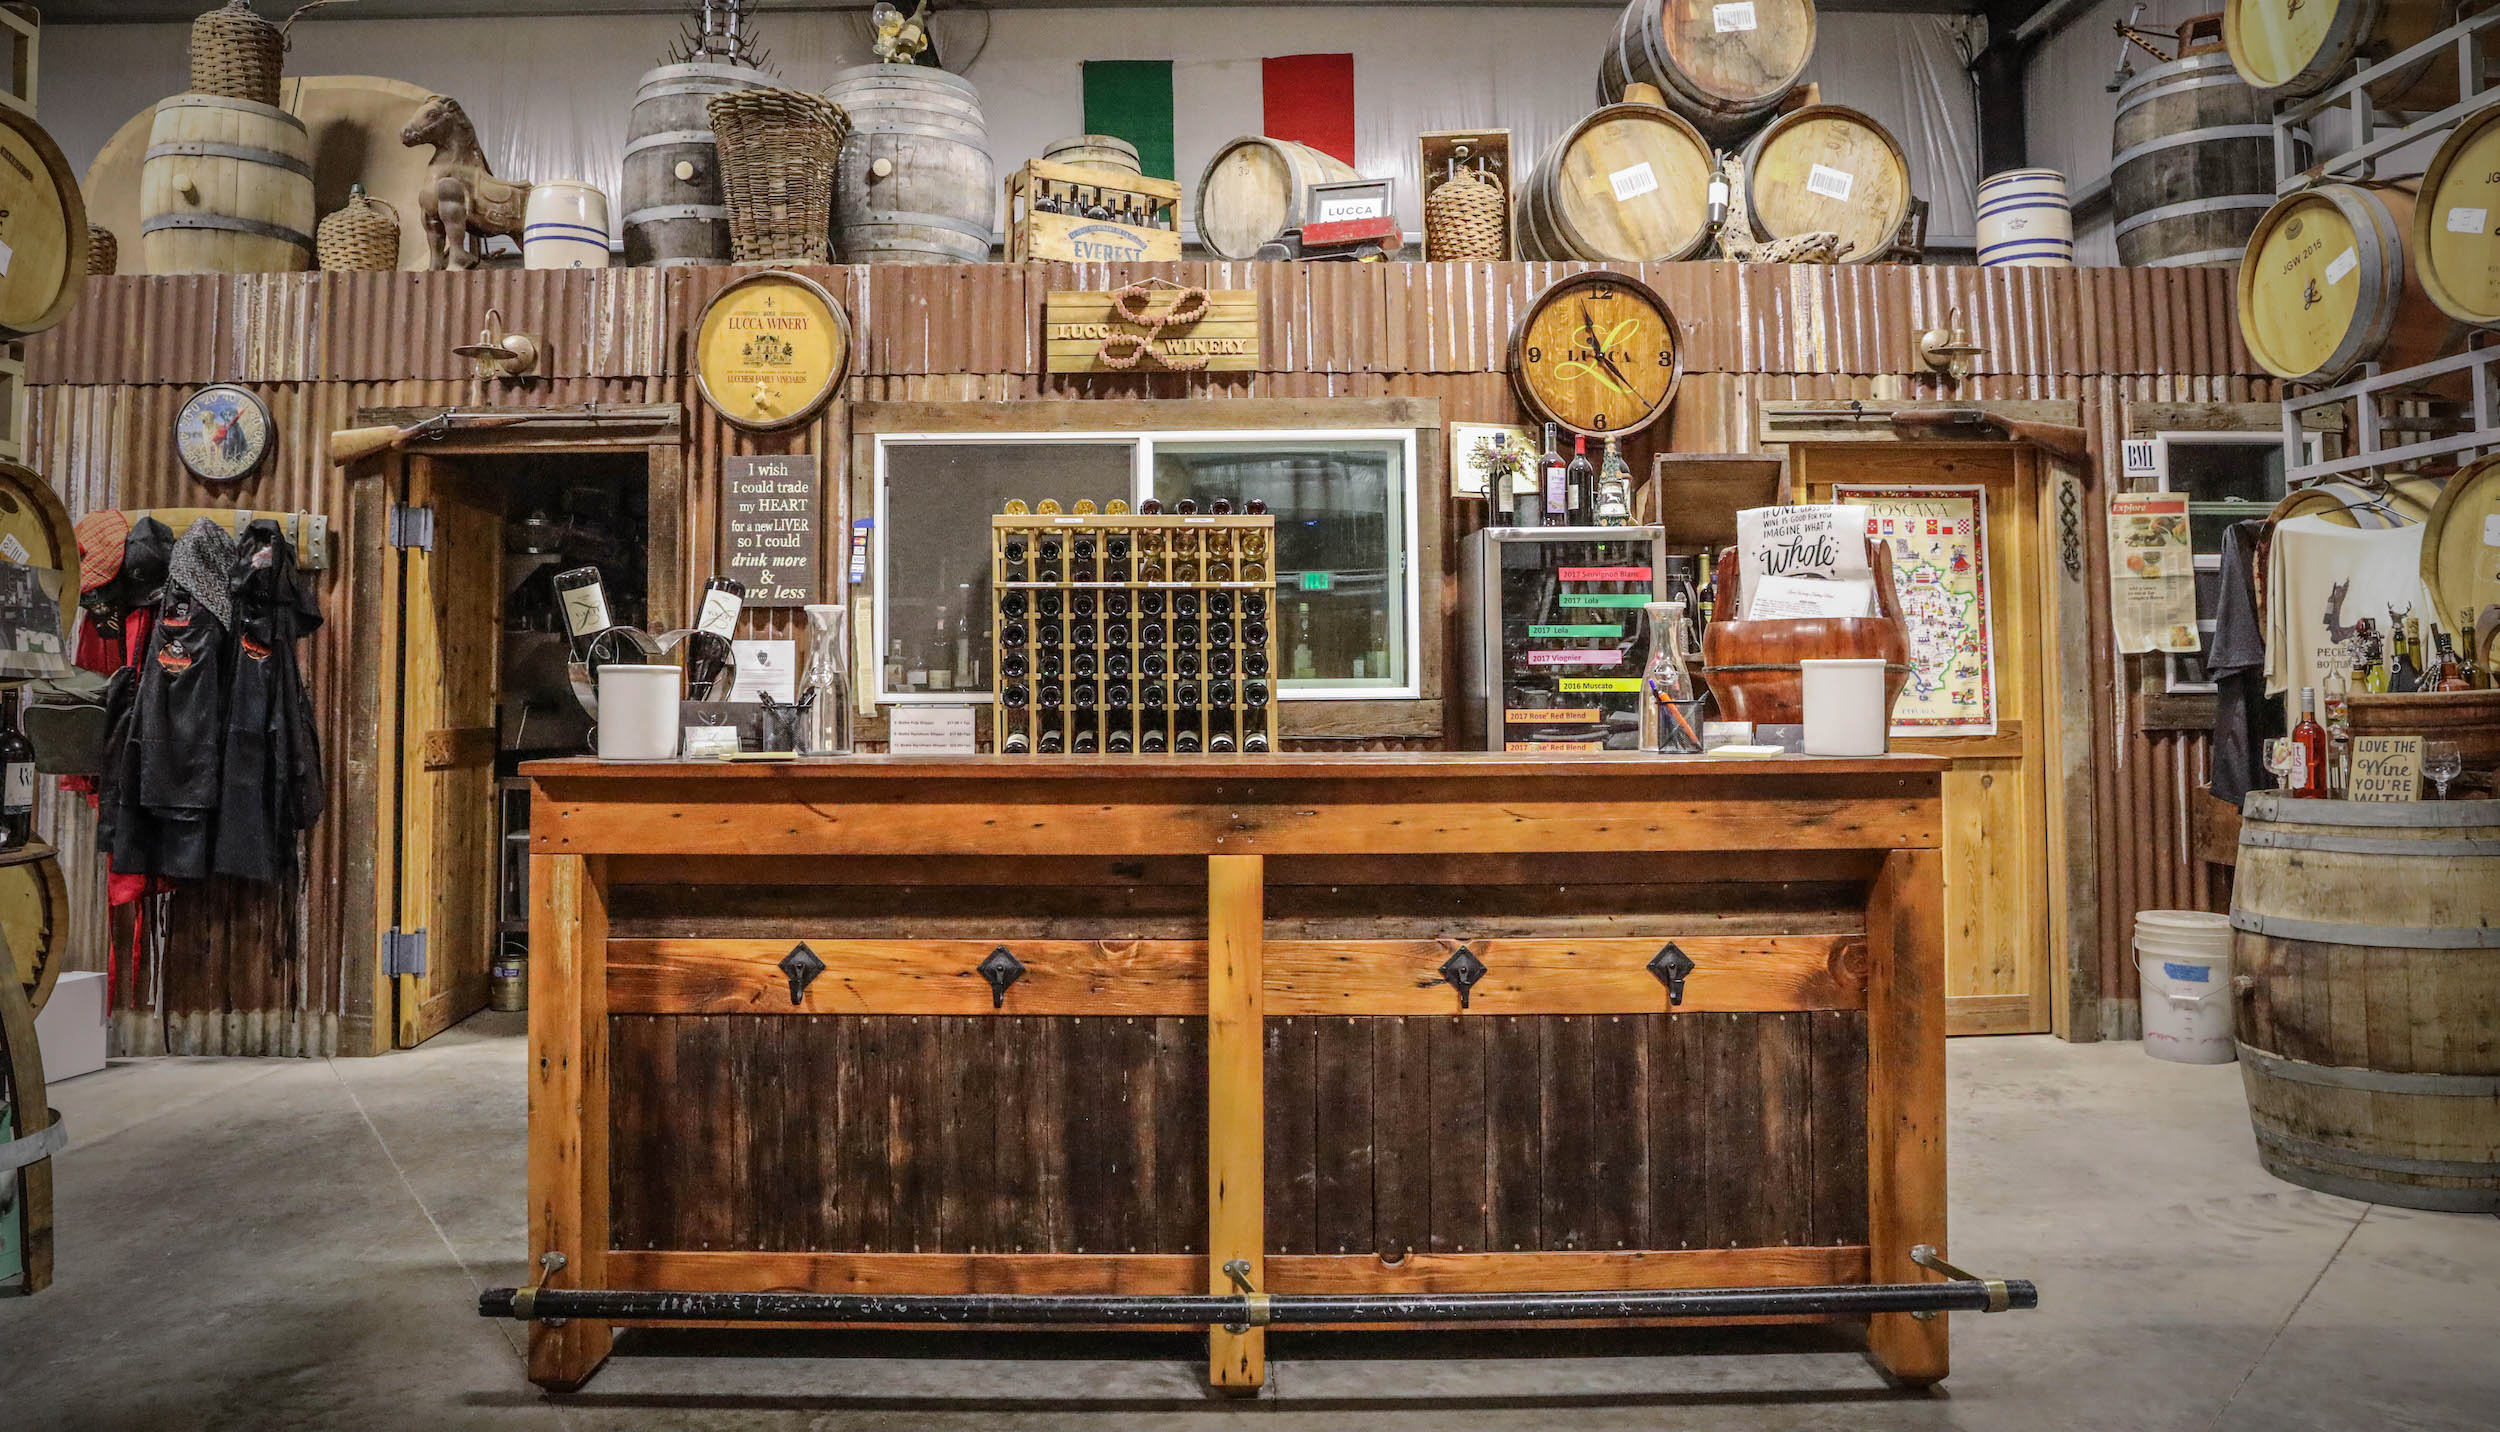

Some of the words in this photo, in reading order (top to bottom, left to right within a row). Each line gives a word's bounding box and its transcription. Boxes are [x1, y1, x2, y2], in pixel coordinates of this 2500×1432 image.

[1328, 206, 1373, 216] LUCCA
[1073, 240, 1143, 261] EVEREST
[2282, 254, 2301, 275] JGW
[2303, 239, 2323, 260] 2015
[1589, 283, 1613, 300] 12
[729, 317, 763, 330] LUCCA
[767, 317, 809, 330] WINERY
[1165, 339, 1246, 355] WINERY
[1528, 347, 1541, 363] 9
[1658, 351, 1672, 367] 3
[1593, 413, 1607, 429] 6
[749, 463, 754, 475] I
[758, 463, 788, 476] wish
[733, 481, 738, 493] I
[741, 480, 774, 493] could
[777, 480, 809, 493] trade
[740, 503, 755, 514] my
[759, 499, 808, 512] HEART
[1871, 503, 1952, 517] TOSCANA
[2112, 503, 2147, 513] Explore
[1763, 510, 1770, 519] IF
[1763, 518, 1779, 528] WINE
[1791, 514, 1807, 523] GOOD
[732, 520, 745, 532] for
[747, 523, 752, 532] a
[754, 523, 773, 532] new
[774, 518, 809, 531] LIVER
[1763, 524, 1801, 539] IMAGINE
[1805, 521, 1825, 533] WHAT
[1827, 521, 1833, 530] A
[737, 537, 752, 547] so
[756, 535, 761, 547] I
[765, 534, 800, 547] could
[732, 553, 768, 567] drink
[772, 556, 807, 567] more
[760, 569, 775, 584] &
[1563, 570, 1581, 578] 2017
[1582, 570, 1619, 580] Sauvignon
[774, 585, 807, 599] less
[1551, 654, 1582, 663] Viognier
[1564, 682, 1581, 690] 2016
[1582, 682, 1613, 690] Muscato
[1510, 713, 1528, 721] 2017
[1550, 712, 1565, 720] Red
[1565, 711, 1587, 720] Blend
[1565, 742, 1587, 750] Blend
[2359, 740, 2388, 753] LOVE
[2394, 740, 2416, 753] THE
[2357, 754, 2413, 777] Wine
[2355, 779, 2412, 791] YOU'RE
